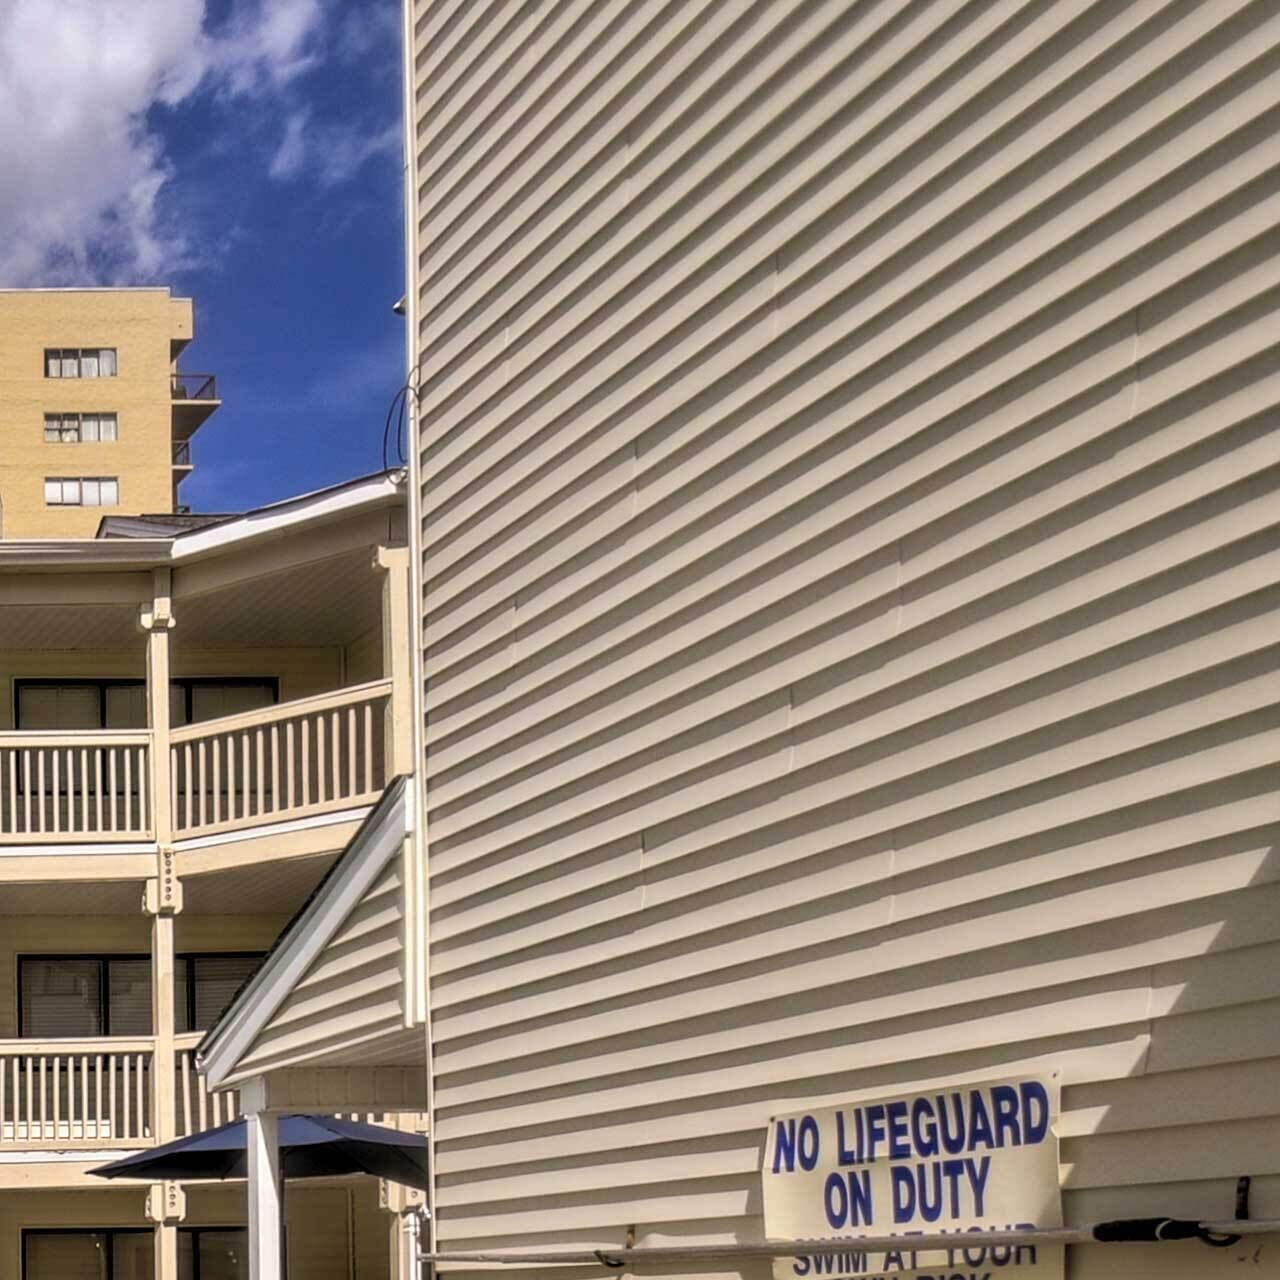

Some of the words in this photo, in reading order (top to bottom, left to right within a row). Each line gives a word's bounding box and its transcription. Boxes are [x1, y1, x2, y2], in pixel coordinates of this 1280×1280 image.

[772, 1115, 820, 1174] NO
[836, 1081, 1050, 1166] LIFEGUARD
[824, 1170, 873, 1230] ON
[890, 1156, 991, 1224] DUTY
